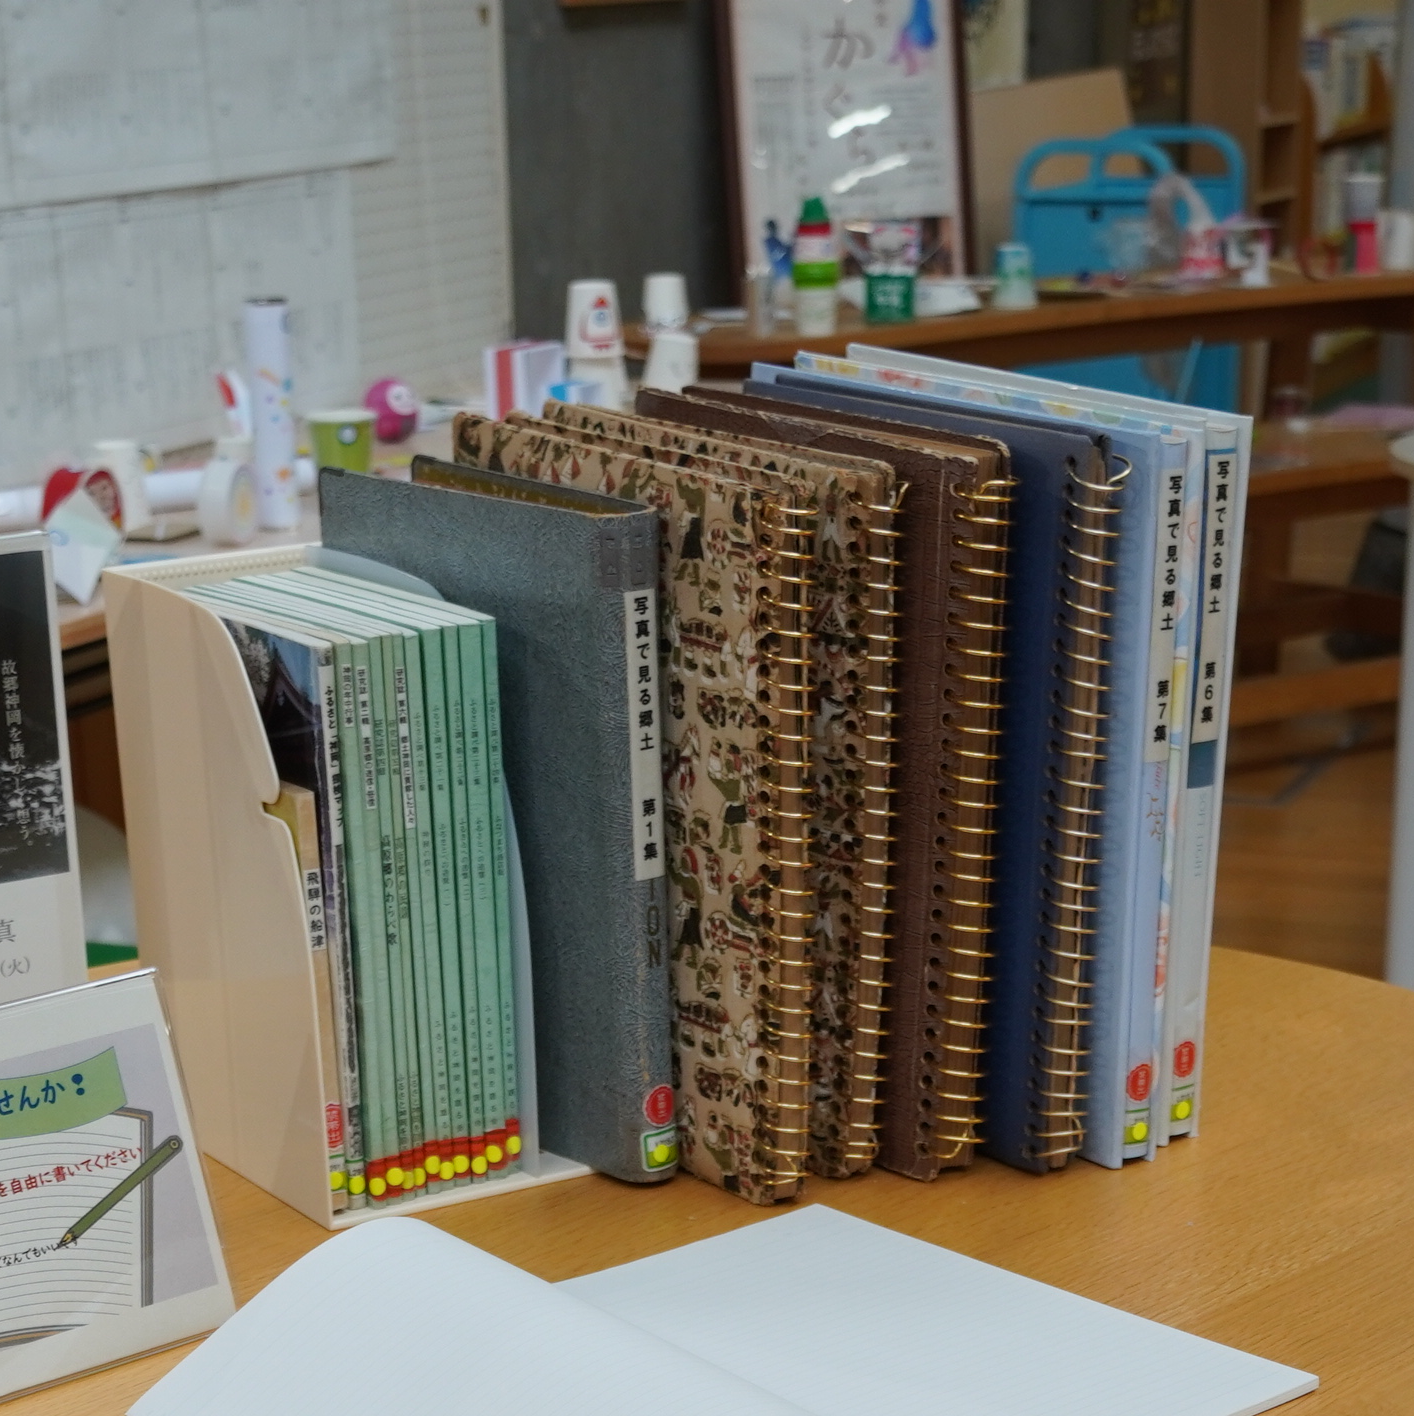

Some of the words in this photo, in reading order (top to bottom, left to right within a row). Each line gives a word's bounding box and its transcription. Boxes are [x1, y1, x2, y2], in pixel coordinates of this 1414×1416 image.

[1159, 474, 1184, 632] 写真で見る郷土
[1207, 460, 1231, 614] 写真で見る郷土
[633, 594, 656, 753] 写真で見る郷土
[1153, 679, 1170, 743] 第7集
[1200, 661, 1217, 724] 第6集
[640, 798, 659, 862] 第1集
[305, 872, 325, 949] 飛騨の船津
